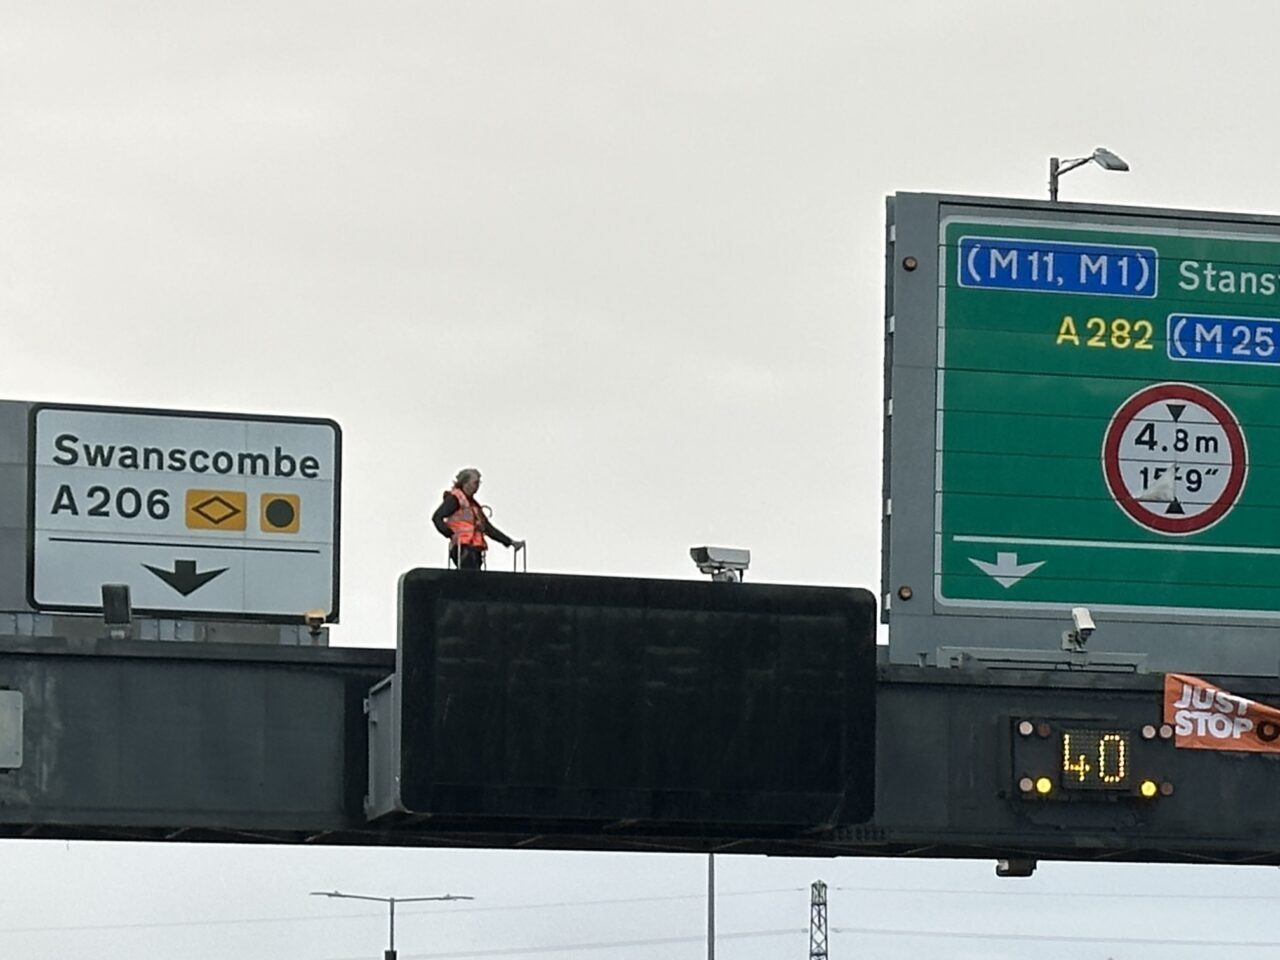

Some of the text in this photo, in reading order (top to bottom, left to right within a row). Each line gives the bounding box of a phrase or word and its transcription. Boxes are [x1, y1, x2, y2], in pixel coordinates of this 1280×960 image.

[1056, 315, 1154, 350] A282
[52, 433, 320, 479] Swanscombe
[50, 483, 171, 520] A206
[1174, 684, 1255, 716] JUST
[1175, 709, 1254, 739] STOP
[1063, 733, 1125, 782] 40
